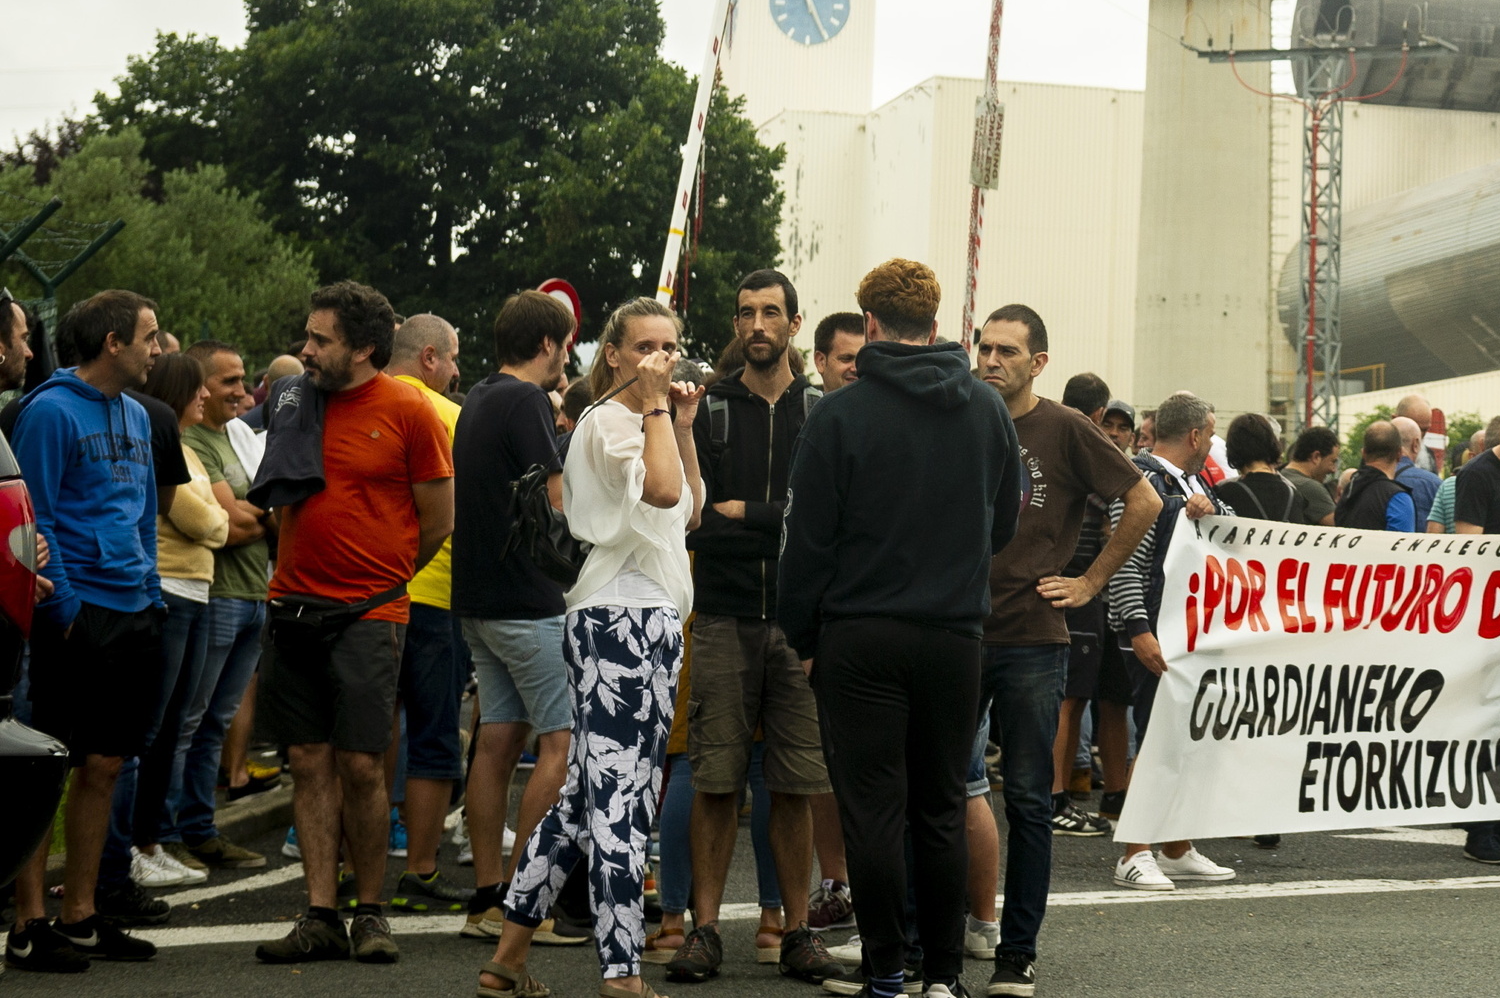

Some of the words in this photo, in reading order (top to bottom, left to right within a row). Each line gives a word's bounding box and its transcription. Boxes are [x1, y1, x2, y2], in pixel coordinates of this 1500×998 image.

[1030, 483, 1047, 508] kill
[1277, 558, 1317, 633] EL
[1323, 563, 1473, 634] FUTURO
[1189, 663, 1445, 741] GUARDIANEKO
